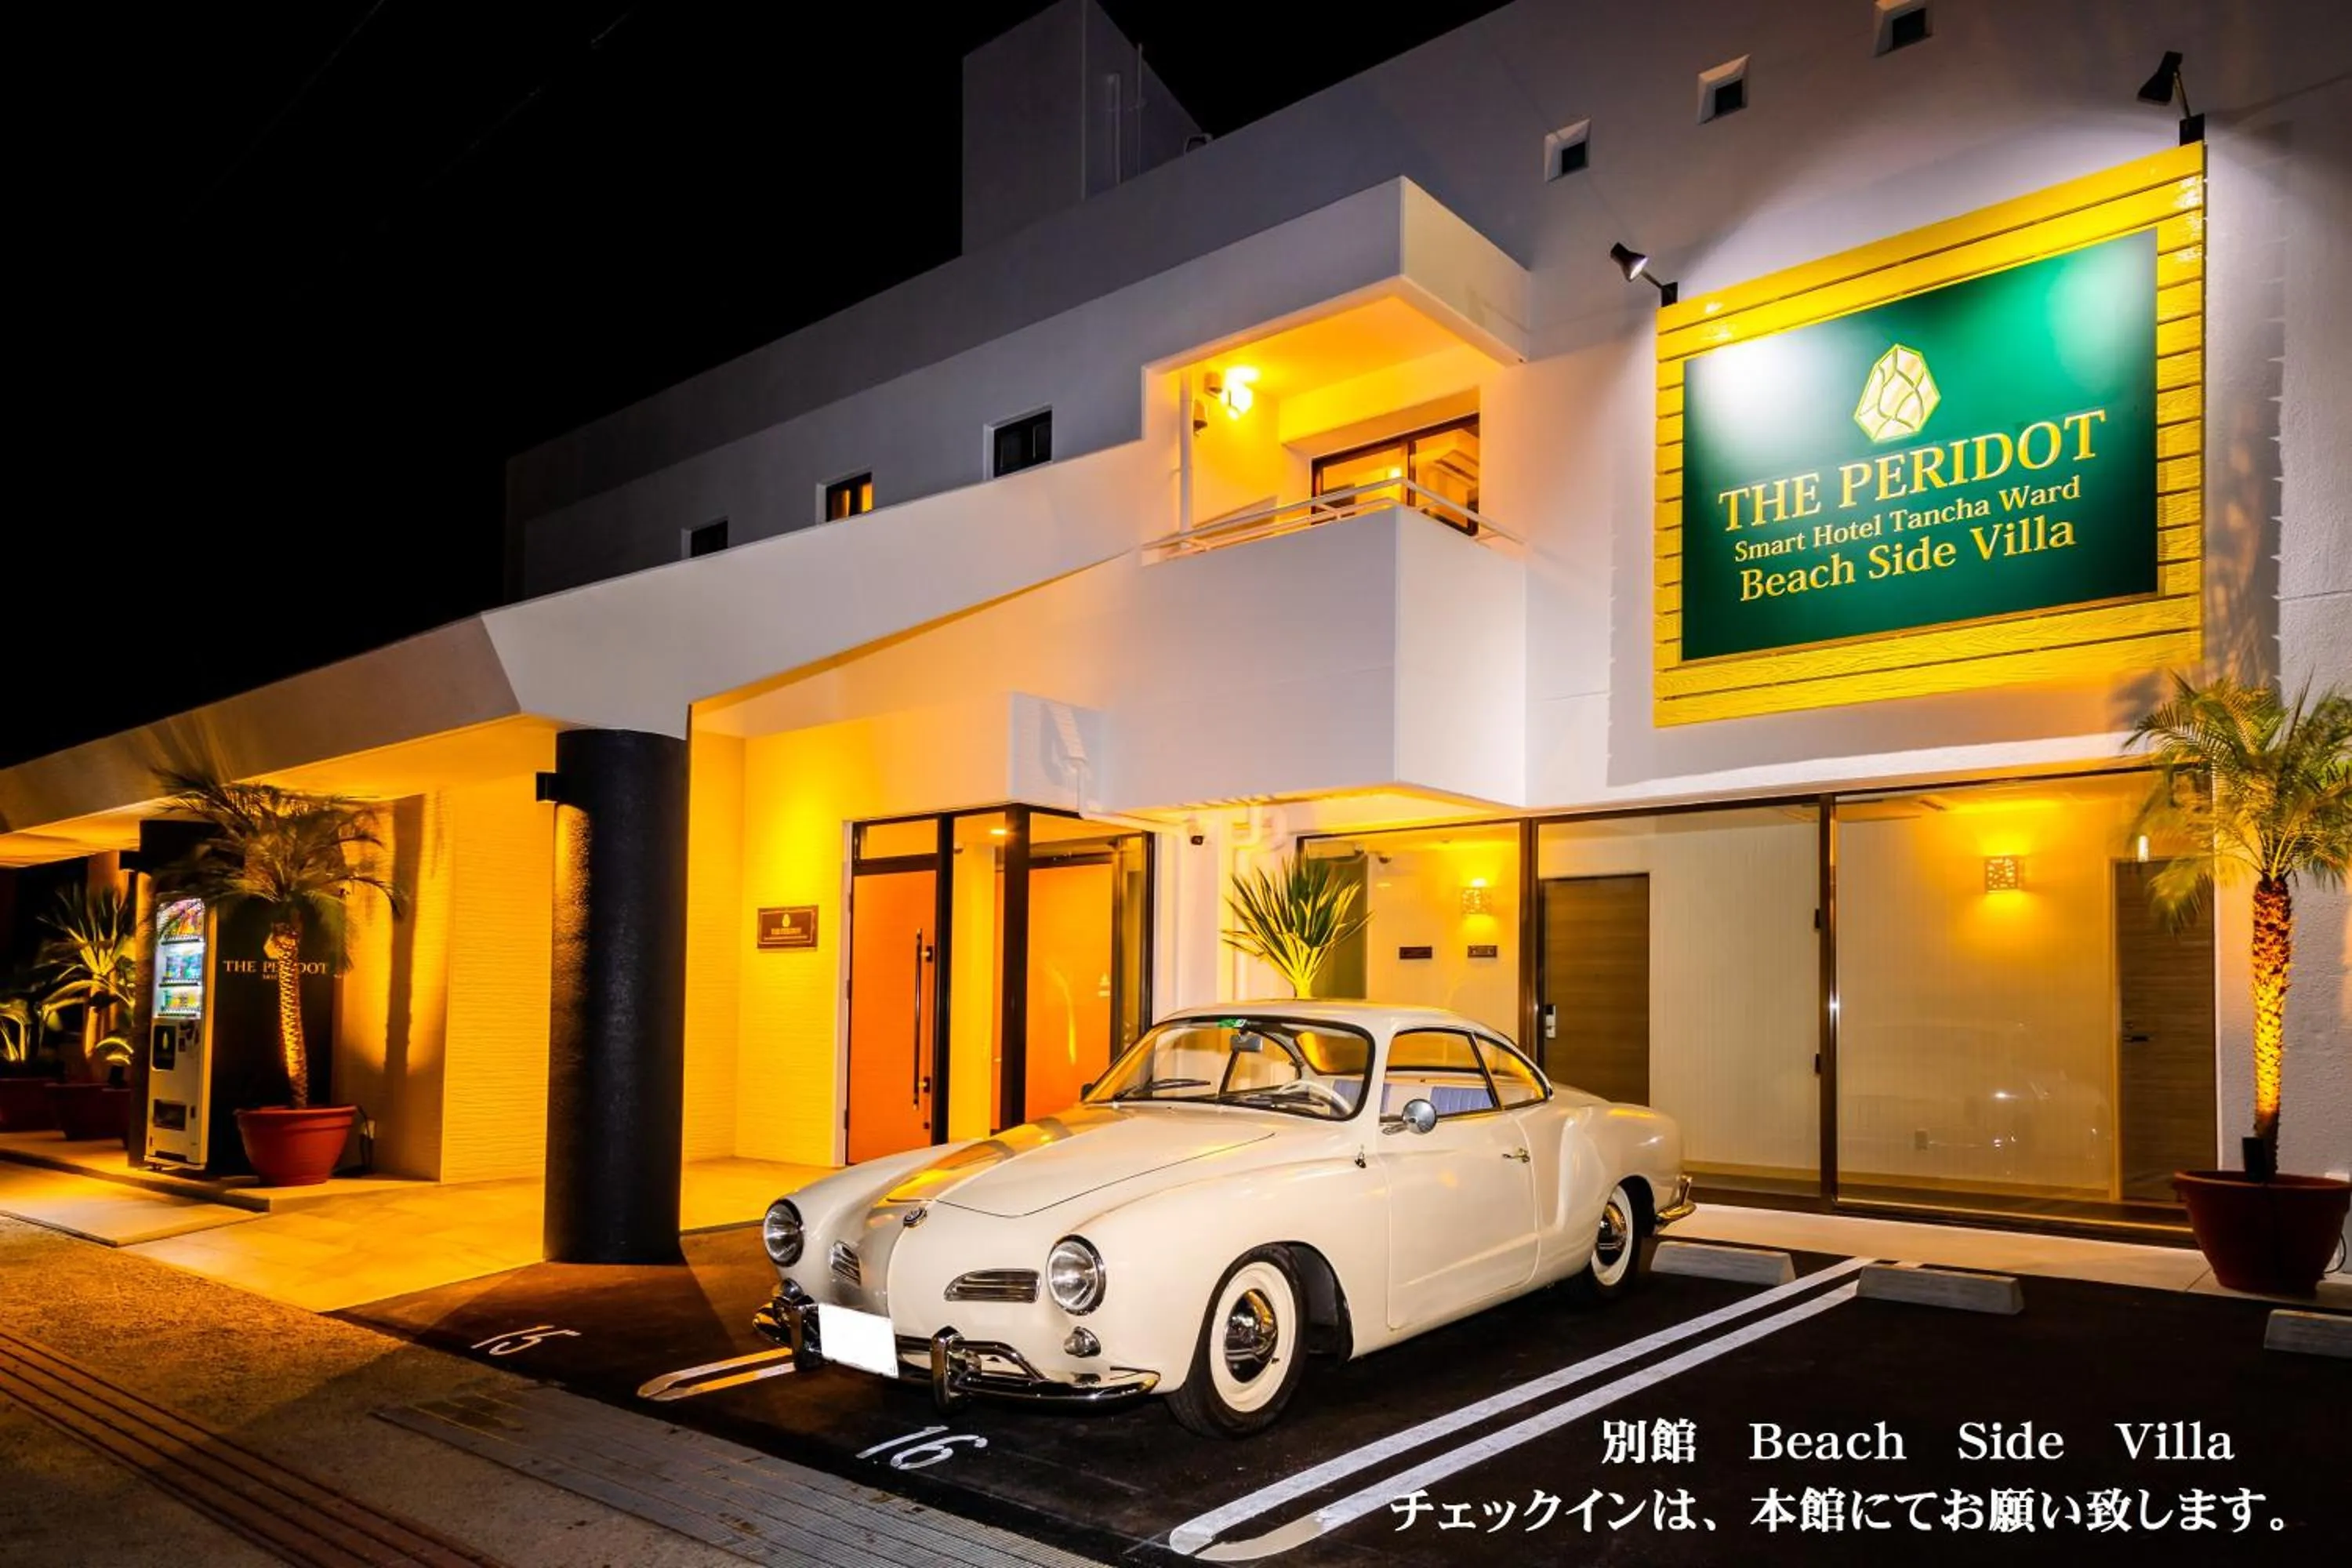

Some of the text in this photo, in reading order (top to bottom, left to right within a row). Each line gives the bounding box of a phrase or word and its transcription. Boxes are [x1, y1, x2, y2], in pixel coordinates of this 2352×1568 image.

[1719, 408, 2107, 532] THE PERIDOT
[1735, 474, 2082, 562] Smart Hotel Tancha Ward
[1740, 514, 2078, 602] Beach Side Villa
[222, 960, 328, 975] THE PEDOT
[855, 1425, 989, 1470] 16
